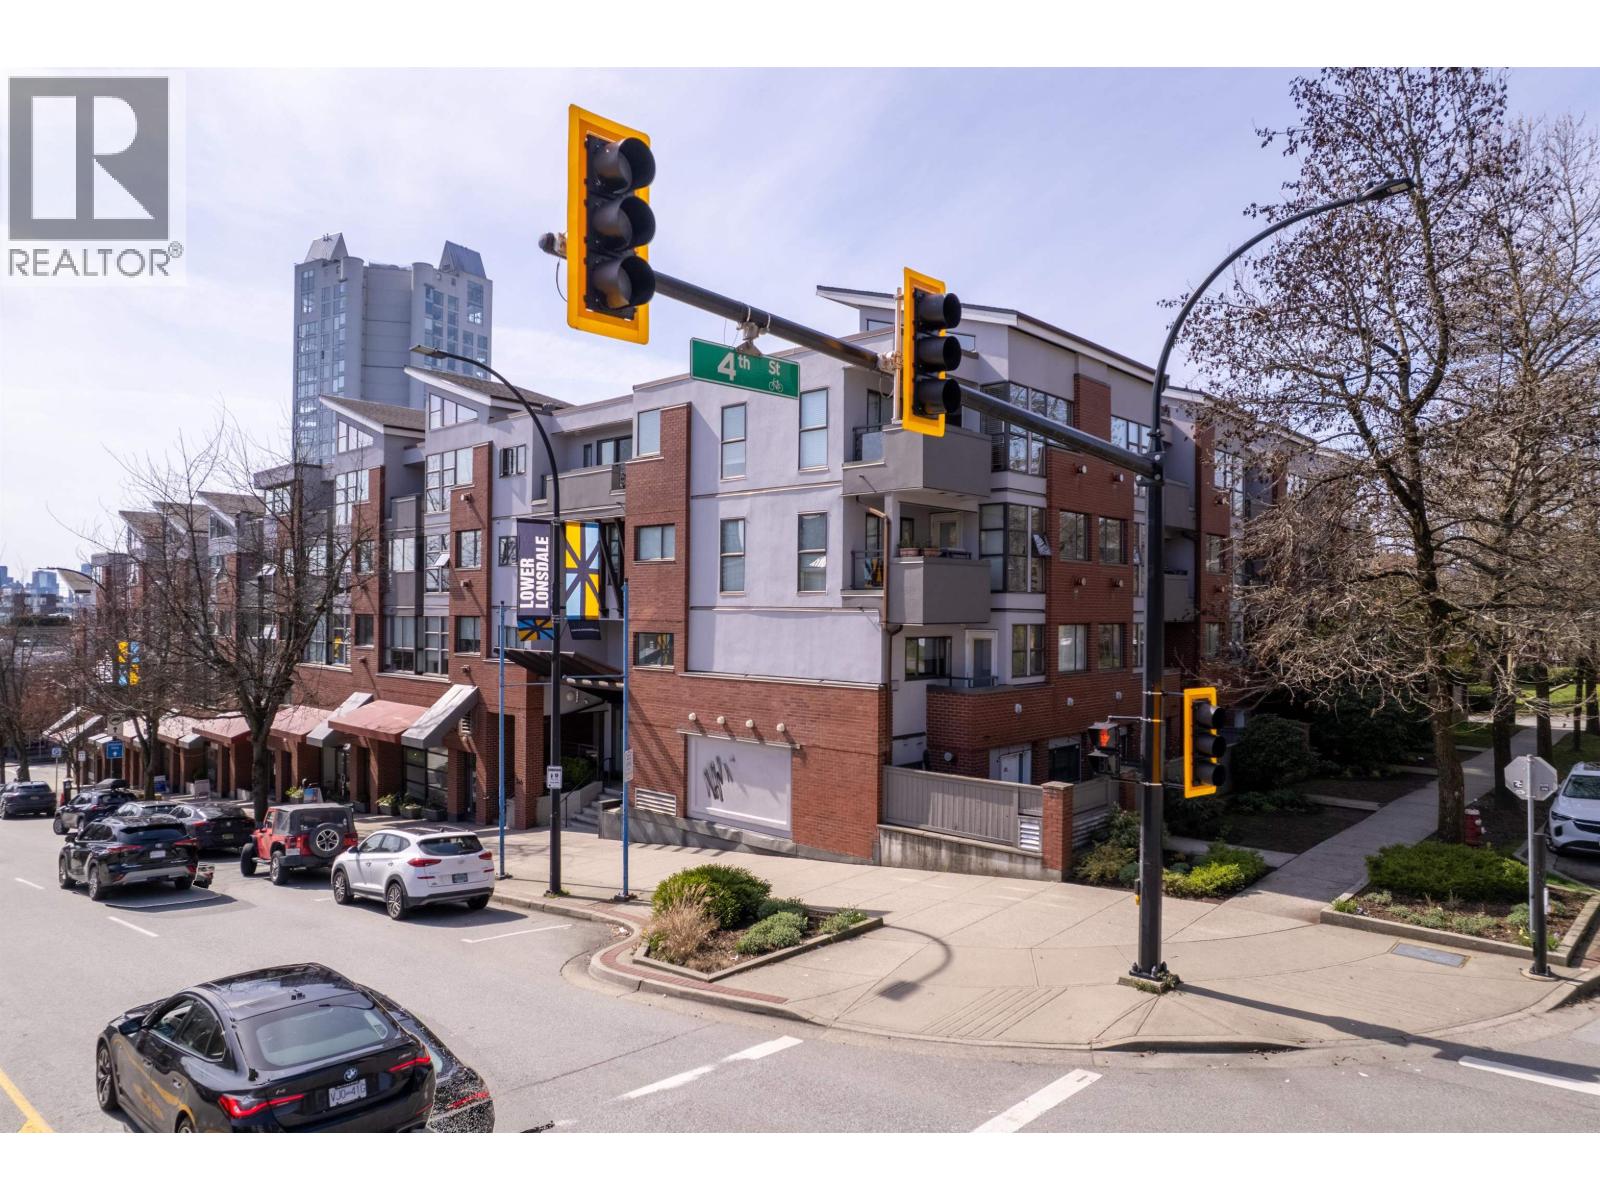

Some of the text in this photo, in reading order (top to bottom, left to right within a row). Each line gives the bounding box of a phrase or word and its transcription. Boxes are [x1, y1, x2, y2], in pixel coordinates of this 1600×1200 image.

[717, 351, 781, 381] 4th St
[519, 558, 535, 609] LOWER
[535, 536, 549, 609] LONSDALE
